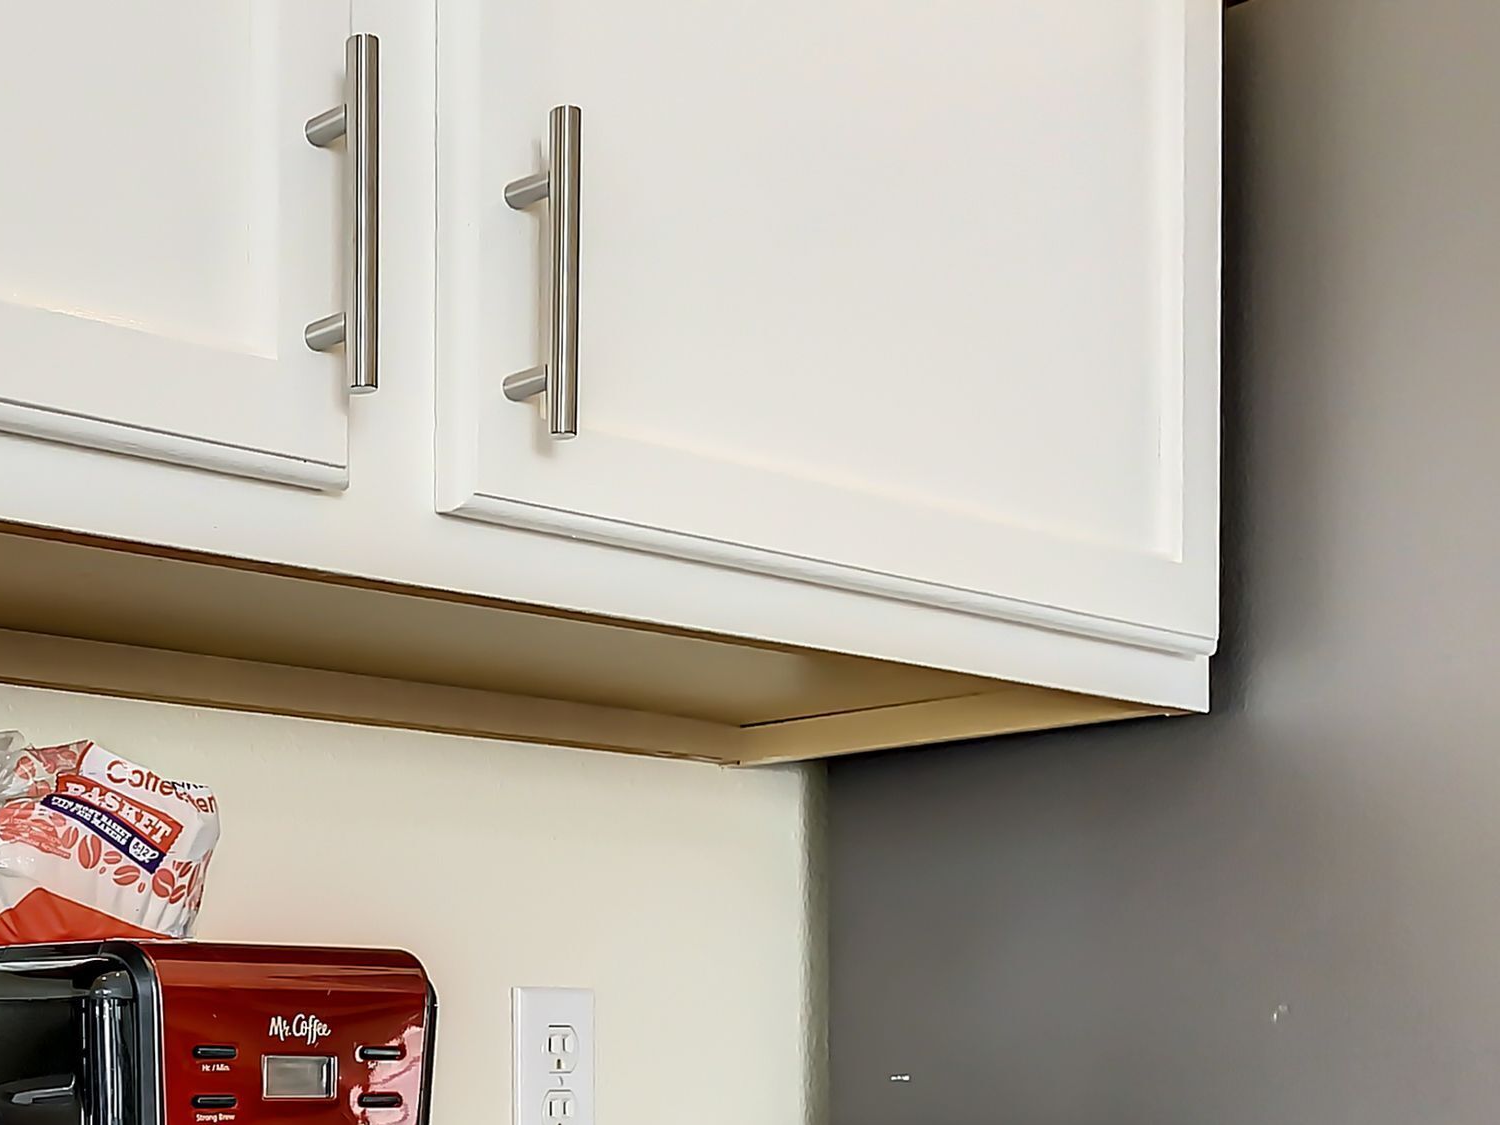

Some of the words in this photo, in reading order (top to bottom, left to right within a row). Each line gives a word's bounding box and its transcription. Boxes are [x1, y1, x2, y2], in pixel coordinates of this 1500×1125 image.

[61, 782, 173, 844] BASKET
[102, 813, 132, 838] BASKET
[91, 818, 128, 846] MAKERS
[269, 1015, 291, 1042] Mr.
[292, 1013, 332, 1046] Coffee
[196, 1113, 218, 1123] Strong
[218, 1112, 236, 1122] Brew
